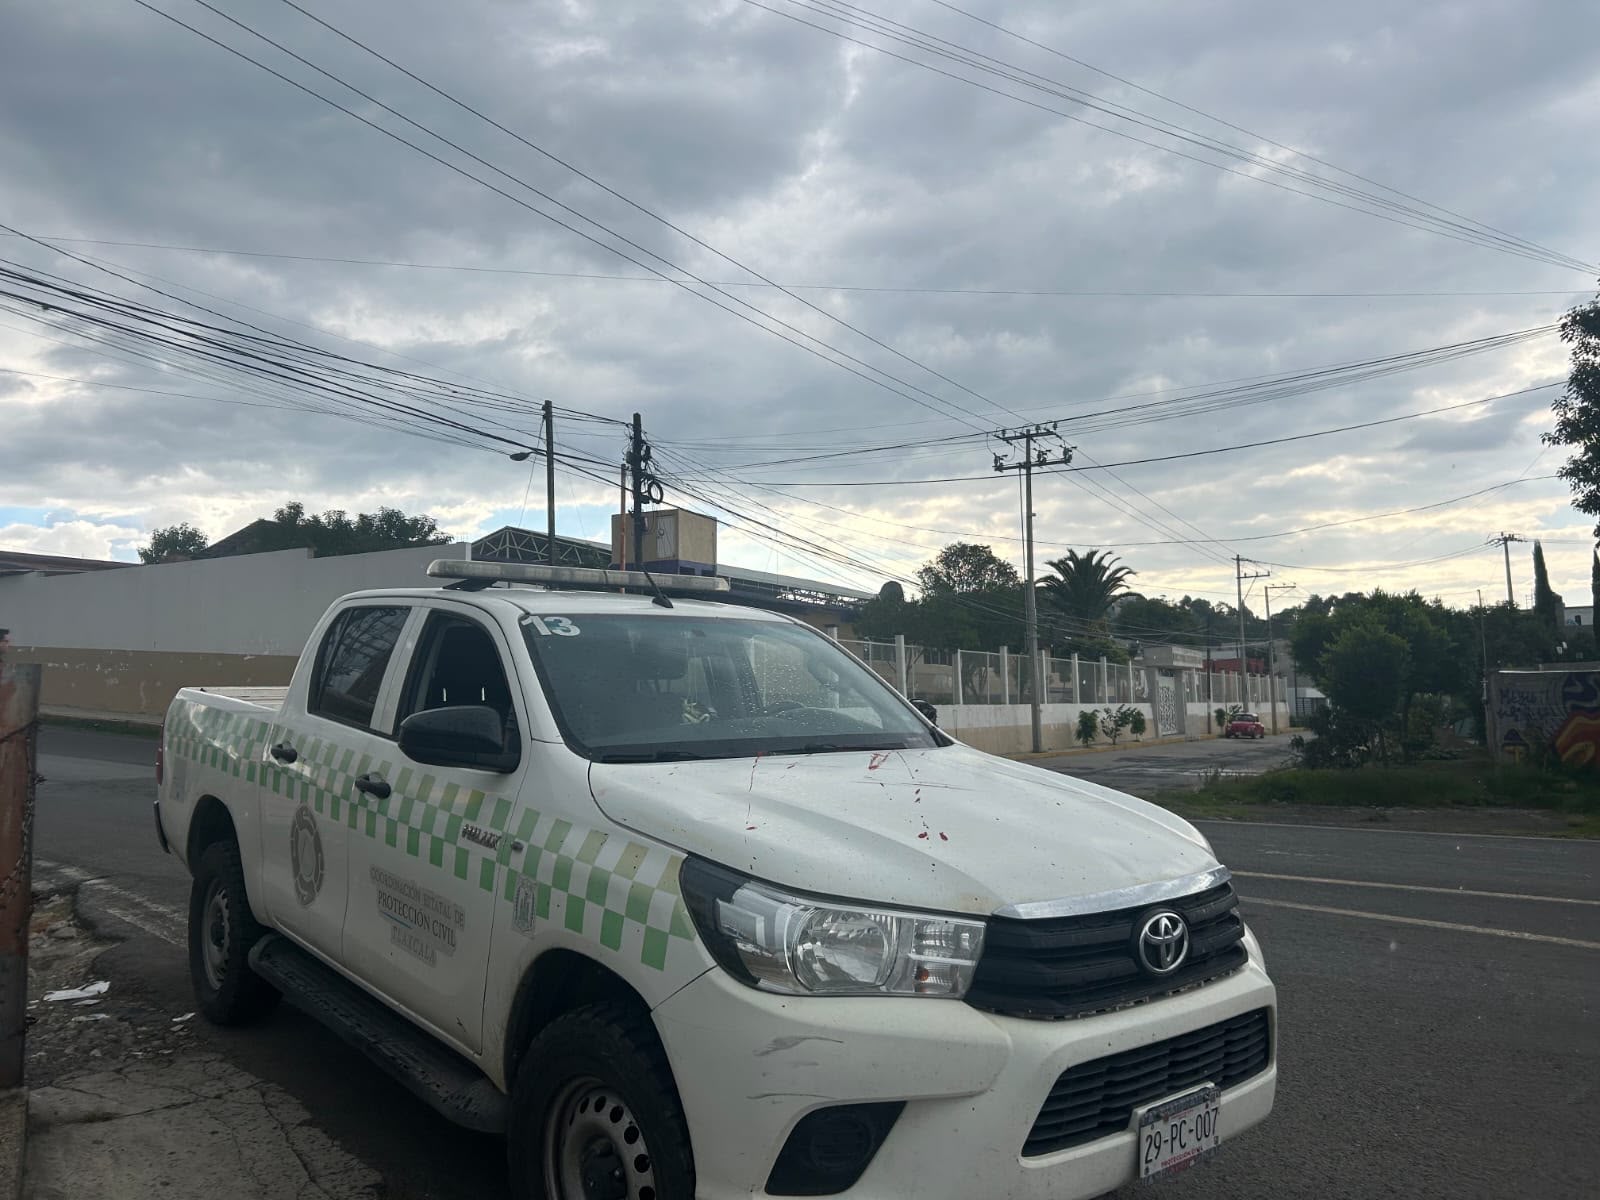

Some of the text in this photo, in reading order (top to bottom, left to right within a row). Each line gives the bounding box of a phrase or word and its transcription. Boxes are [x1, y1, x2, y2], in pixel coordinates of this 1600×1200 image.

[521, 615, 581, 637] 13
[378, 889, 457, 948] PROTECCIÓN CIVIL
[1144, 1107, 1219, 1165] 29-PC-007
